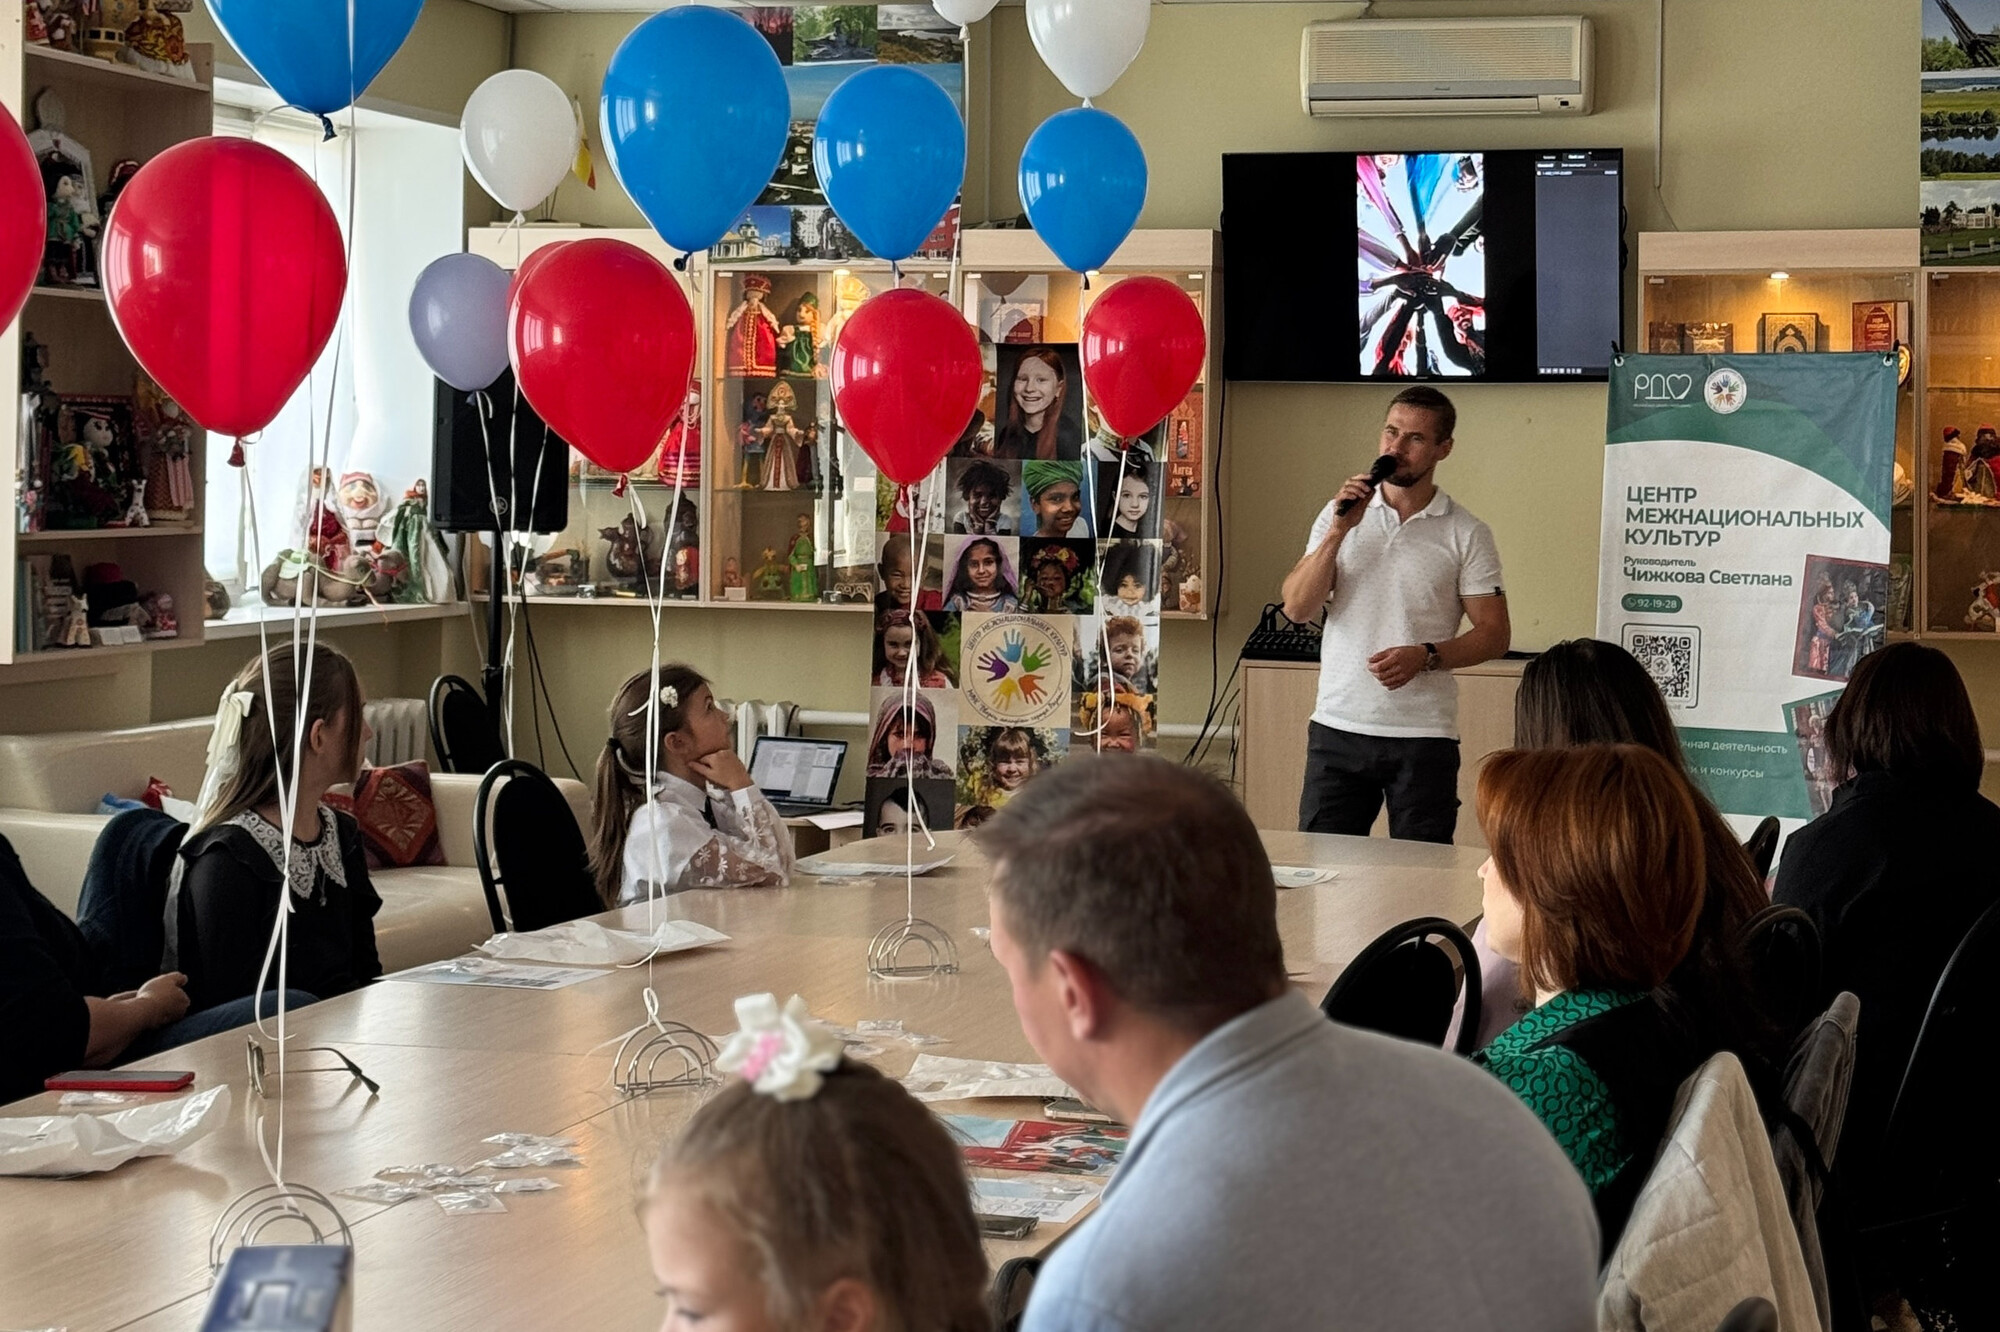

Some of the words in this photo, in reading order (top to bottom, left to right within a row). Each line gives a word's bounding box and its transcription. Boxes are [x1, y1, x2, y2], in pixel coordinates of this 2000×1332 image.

[1626, 486, 1697, 505] ЦЕНТР
[1625, 507, 1865, 529] МЕЖНАЦИОНАЛЬНЫХ
[1624, 528, 1721, 547] КУЛЬТУР
[1624, 556, 1697, 567] Руководитель
[1623, 566, 1705, 584] Чижкова
[1709, 569, 1793, 586] Светлана
[1637, 598, 1678, 609] 92-19-28
[1711, 741, 1788, 754] деятельность
[1710, 767, 1764, 779] конкурсы
